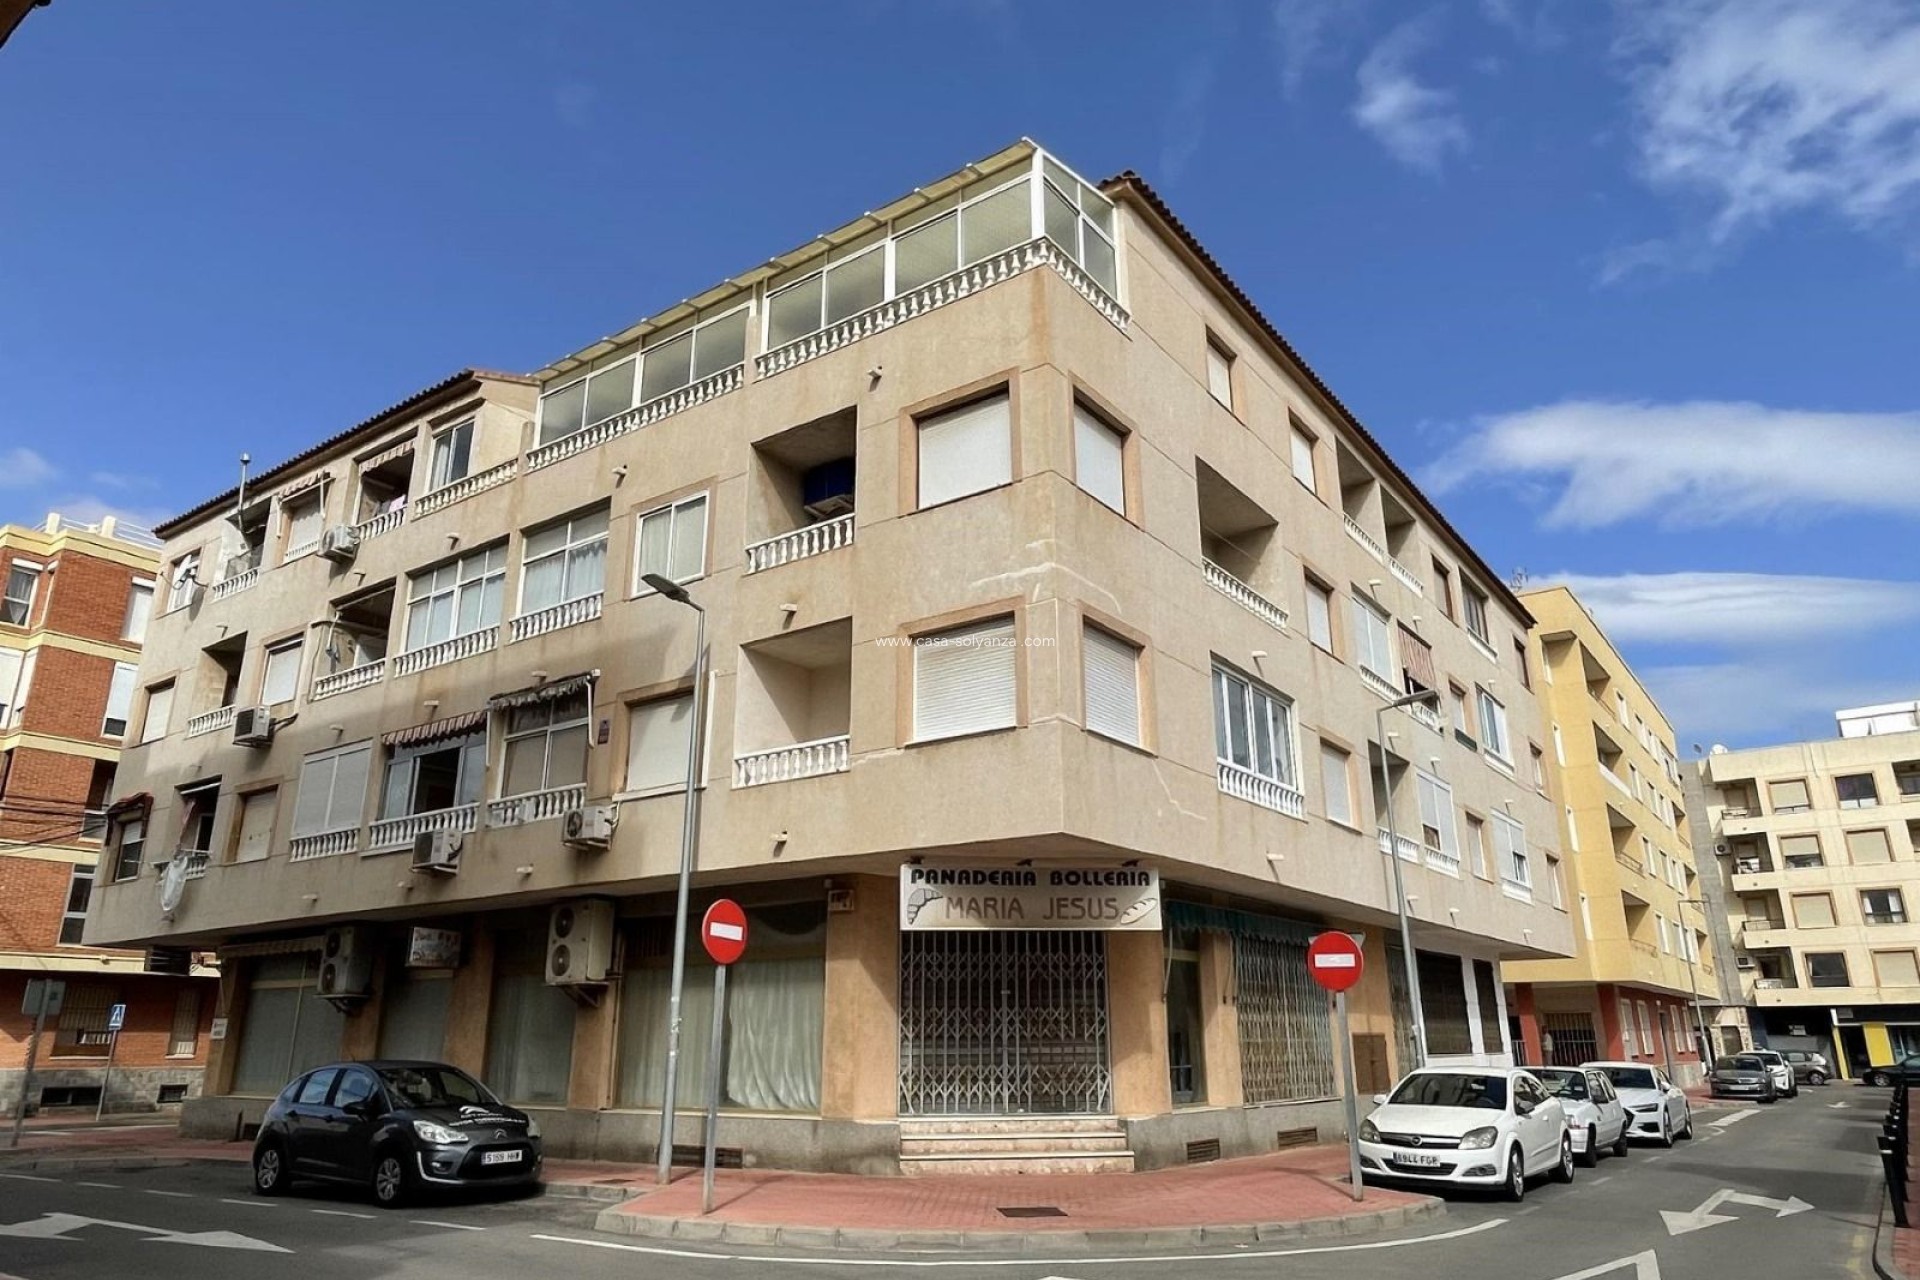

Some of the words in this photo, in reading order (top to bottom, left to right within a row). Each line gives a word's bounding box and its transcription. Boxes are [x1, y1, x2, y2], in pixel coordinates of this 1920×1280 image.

[910, 868, 1037, 887] PANADERIA
[1049, 869, 1150, 887] BOLLERIA
[945, 896, 1024, 921] MARIA
[1042, 897, 1120, 921] JESUS
